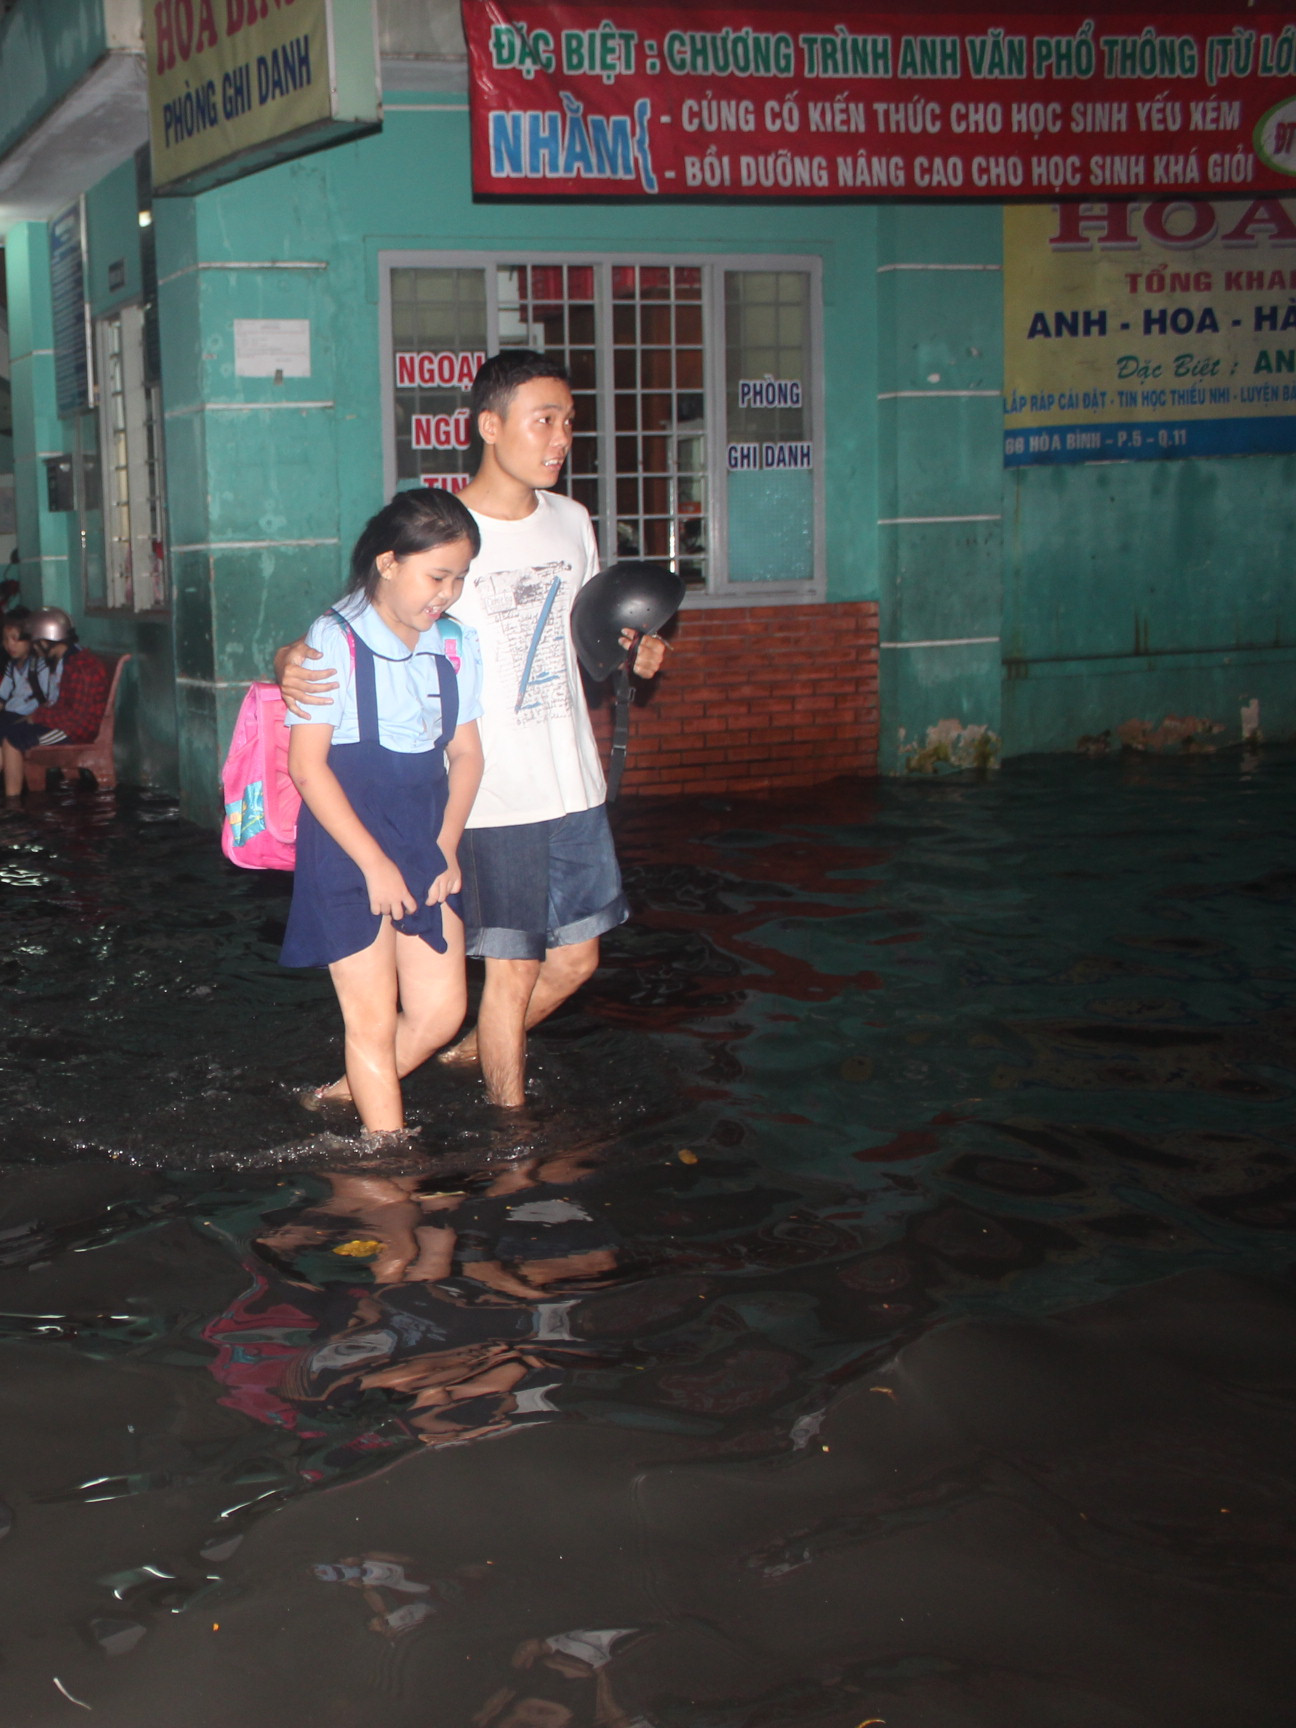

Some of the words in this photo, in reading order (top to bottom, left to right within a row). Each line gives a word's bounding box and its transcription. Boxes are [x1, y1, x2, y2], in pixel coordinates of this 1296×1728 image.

[490, 21, 555, 79] ĐẶC
[562, 20, 637, 84] BIỆT
[664, 27, 795, 77] CHƯƠNG
[799, 25, 892, 79] TRÌNH
[898, 34, 961, 79] ANH
[965, 27, 1027, 79] VĂN
[1033, 19, 1095, 79] PHỔ
[1101, 26, 1198, 79] THÔNG
[1258, 24, 1296, 77] LỚ
[163, 80, 218, 148] PHÒNG
[222, 62, 251, 120] GHI
[256, 34, 312, 105] DANH
[682, 90, 755, 132] CỦNG
[764, 90, 800, 132] CỐ
[808, 91, 865, 133] KIẾN
[872, 94, 941, 133] THỨC
[950, 102, 1002, 133] CHO
[1011, 102, 1063, 140] HỌC
[1070, 102, 1127, 133] SINH
[1135, 91, 1181, 132] YẾU
[1189, 93, 1241, 132] KÉM
[489, 91, 636, 180] NHẰM
[685, 146, 730, 187] BỒI
[741, 149, 828, 187] DƯỠNG
[837, 150, 904, 187] NÂNG
[913, 156, 963, 187] CAO
[971, 156, 1023, 187] CHO
[1031, 156, 1082, 193] HỌC
[1089, 156, 1145, 186] SINH
[1153, 148, 1200, 184] KHÁ
[1208, 145, 1254, 184] GIỎI
[1125, 263, 1213, 294] TỔNG
[1027, 310, 1107, 339] ANH
[1143, 307, 1219, 335] HOA
[1117, 355, 1163, 385] Đặc
[1174, 353, 1221, 383] Biệt
[740, 374, 802, 408] PHÒNG
[1117, 390, 1138, 408] TIN
[1141, 390, 1166, 412] HỌC
[1209, 387, 1230, 405] NHI
[413, 409, 472, 449] NGỮ
[728, 442, 758, 470] GHI
[762, 441, 812, 470] DANH
